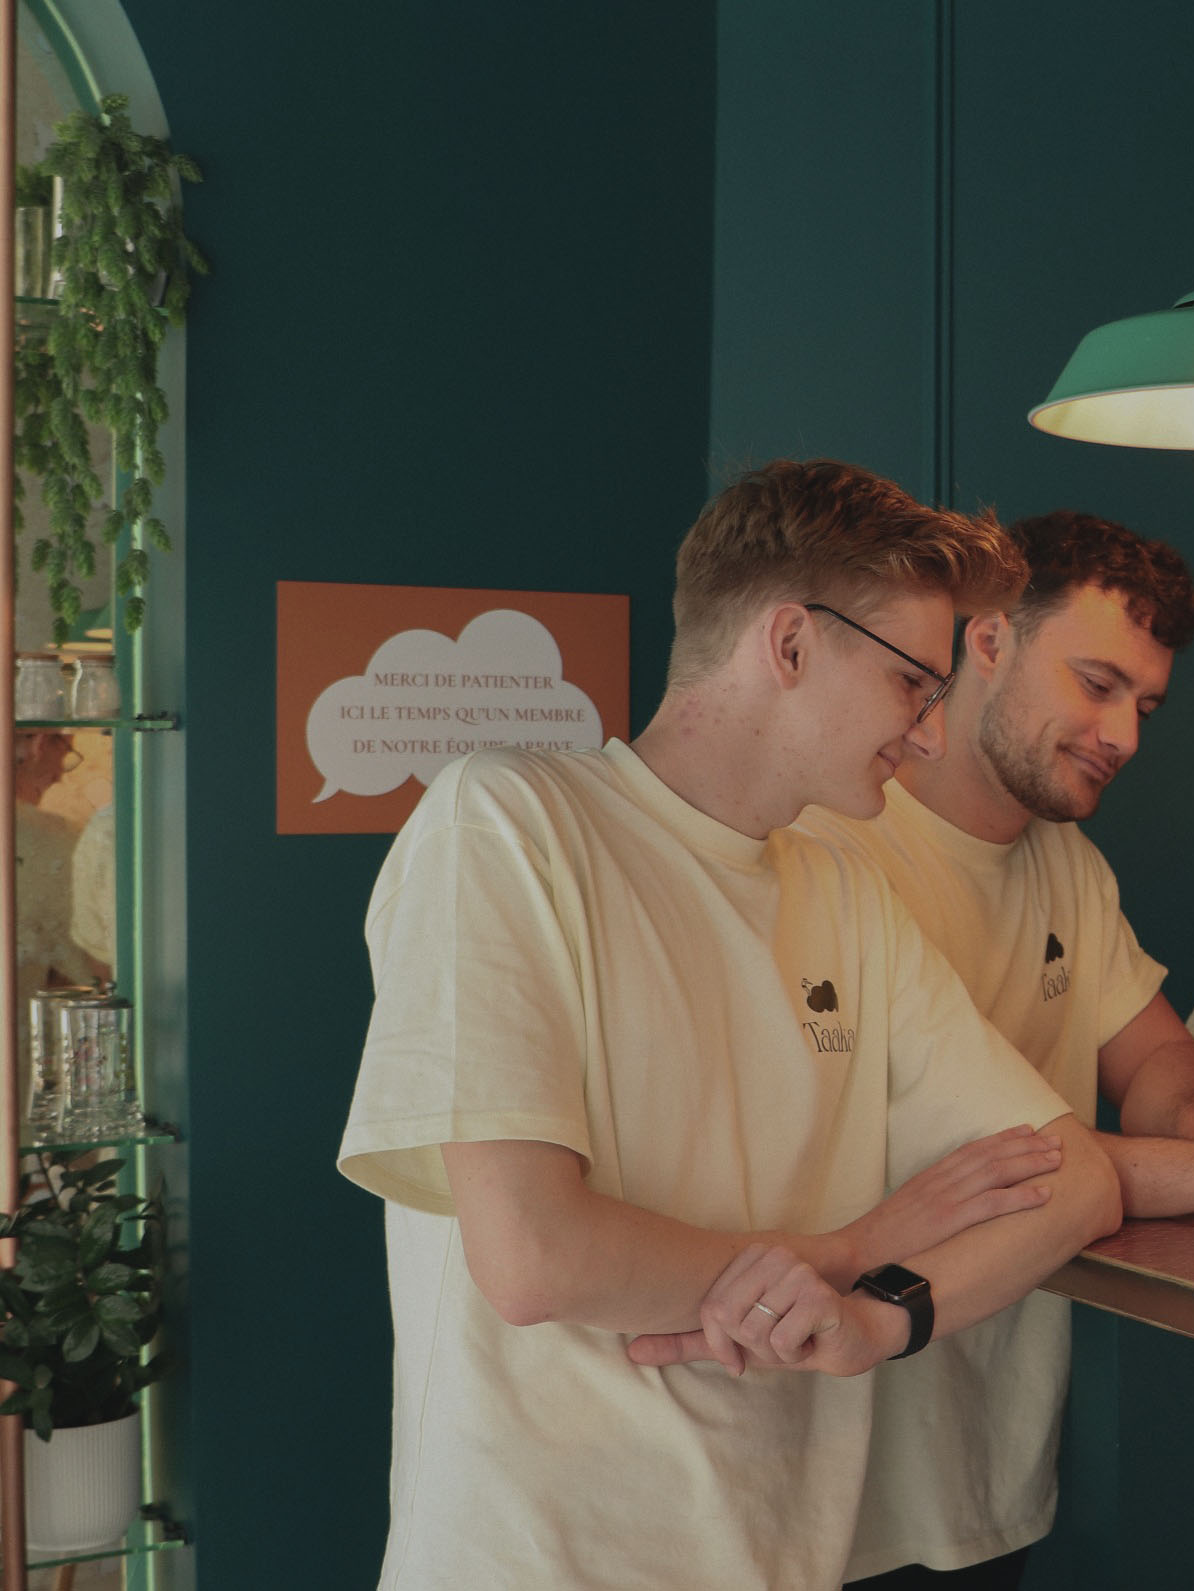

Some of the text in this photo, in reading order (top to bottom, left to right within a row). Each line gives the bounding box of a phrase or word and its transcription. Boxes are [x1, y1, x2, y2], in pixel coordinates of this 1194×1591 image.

[374, 673, 554, 689] MERCI DE PATIENTER
[340, 706, 585, 725] ICI LE TEMPS QU'UN MEMBRE
[353, 739, 376, 753] DE
[381, 739, 442, 754] NOTRE
[802, 1021, 855, 1053] Taaka
